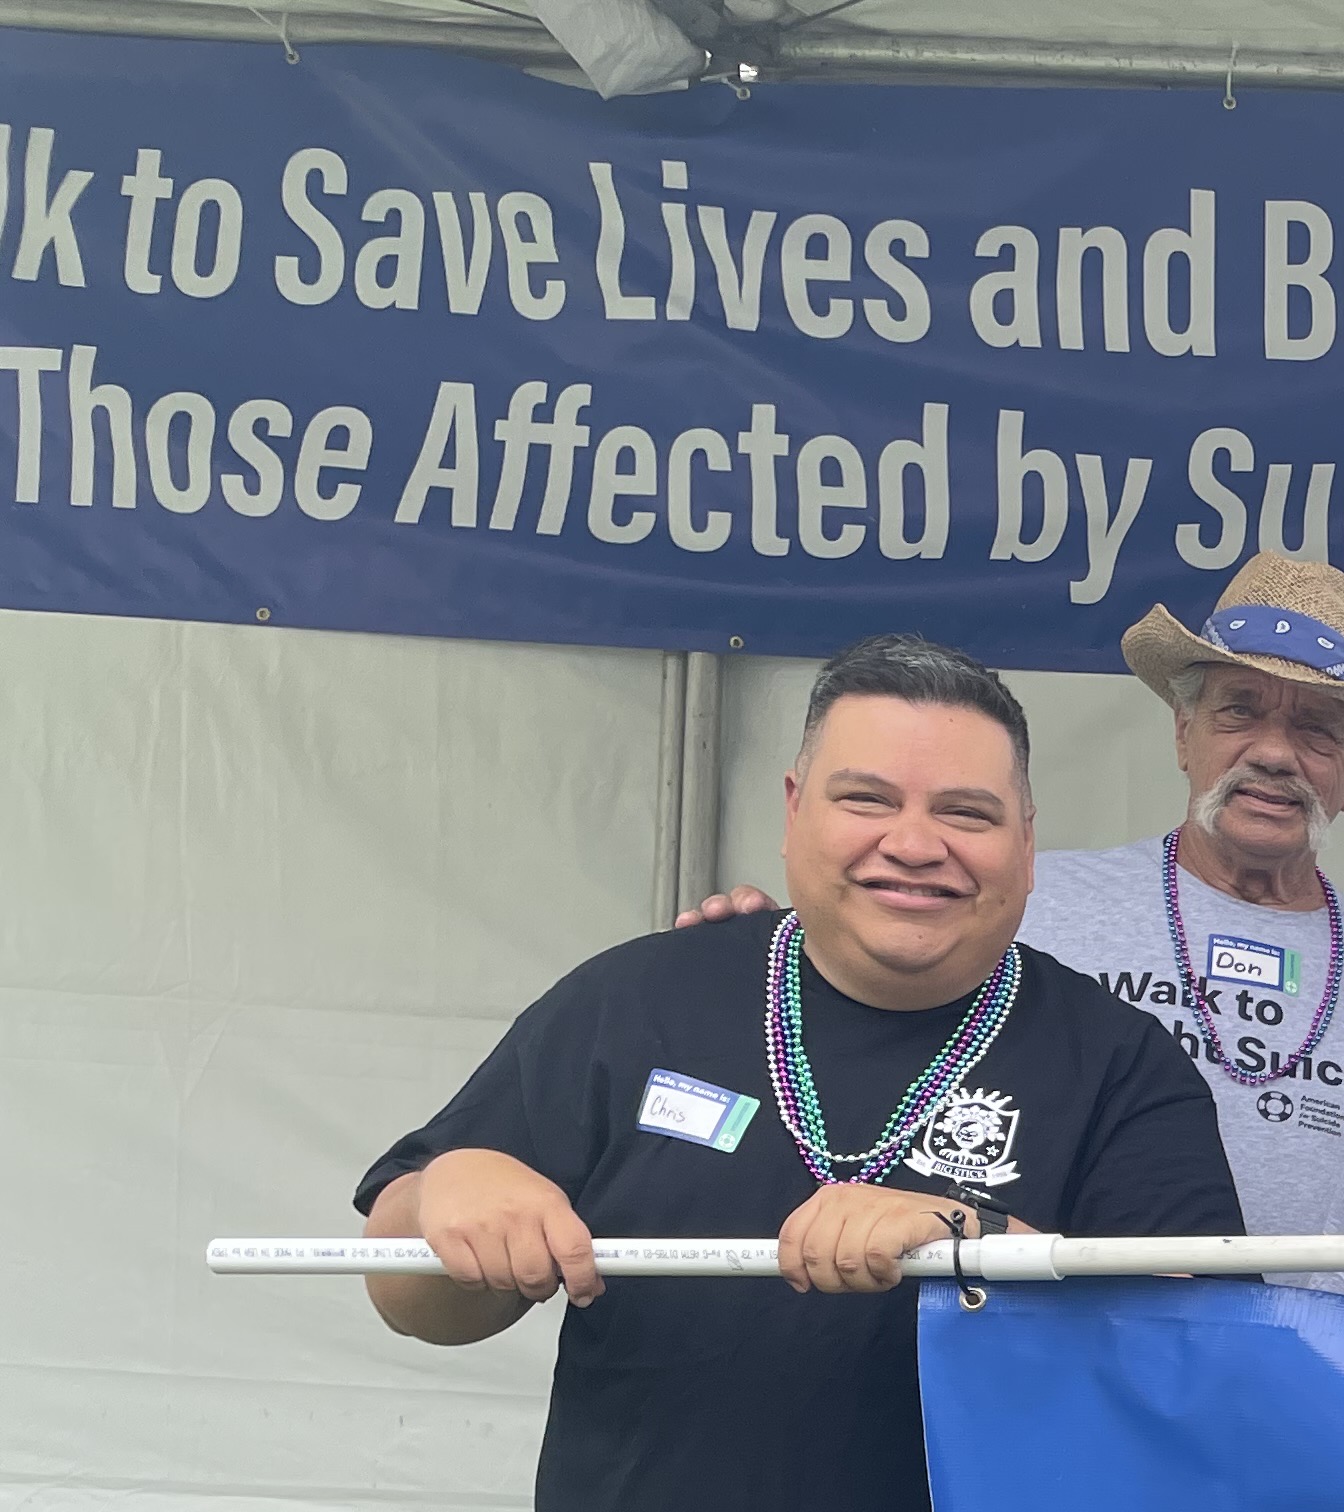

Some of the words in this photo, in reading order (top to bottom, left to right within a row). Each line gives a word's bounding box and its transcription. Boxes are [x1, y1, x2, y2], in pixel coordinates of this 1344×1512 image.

[121, 149, 242, 298] to
[275, 148, 566, 320] Save
[589, 160, 930, 342] Lives
[970, 189, 1216, 356] and
[0, 345, 372, 520] Those
[394, 381, 949, 559] Affected
[990, 409, 1153, 604] by
[1216, 951, 1262, 976] Don
[1099, 972, 1222, 1015] Walk
[1236, 989, 1283, 1026] to
[954, 1166, 986, 1178] STICK
